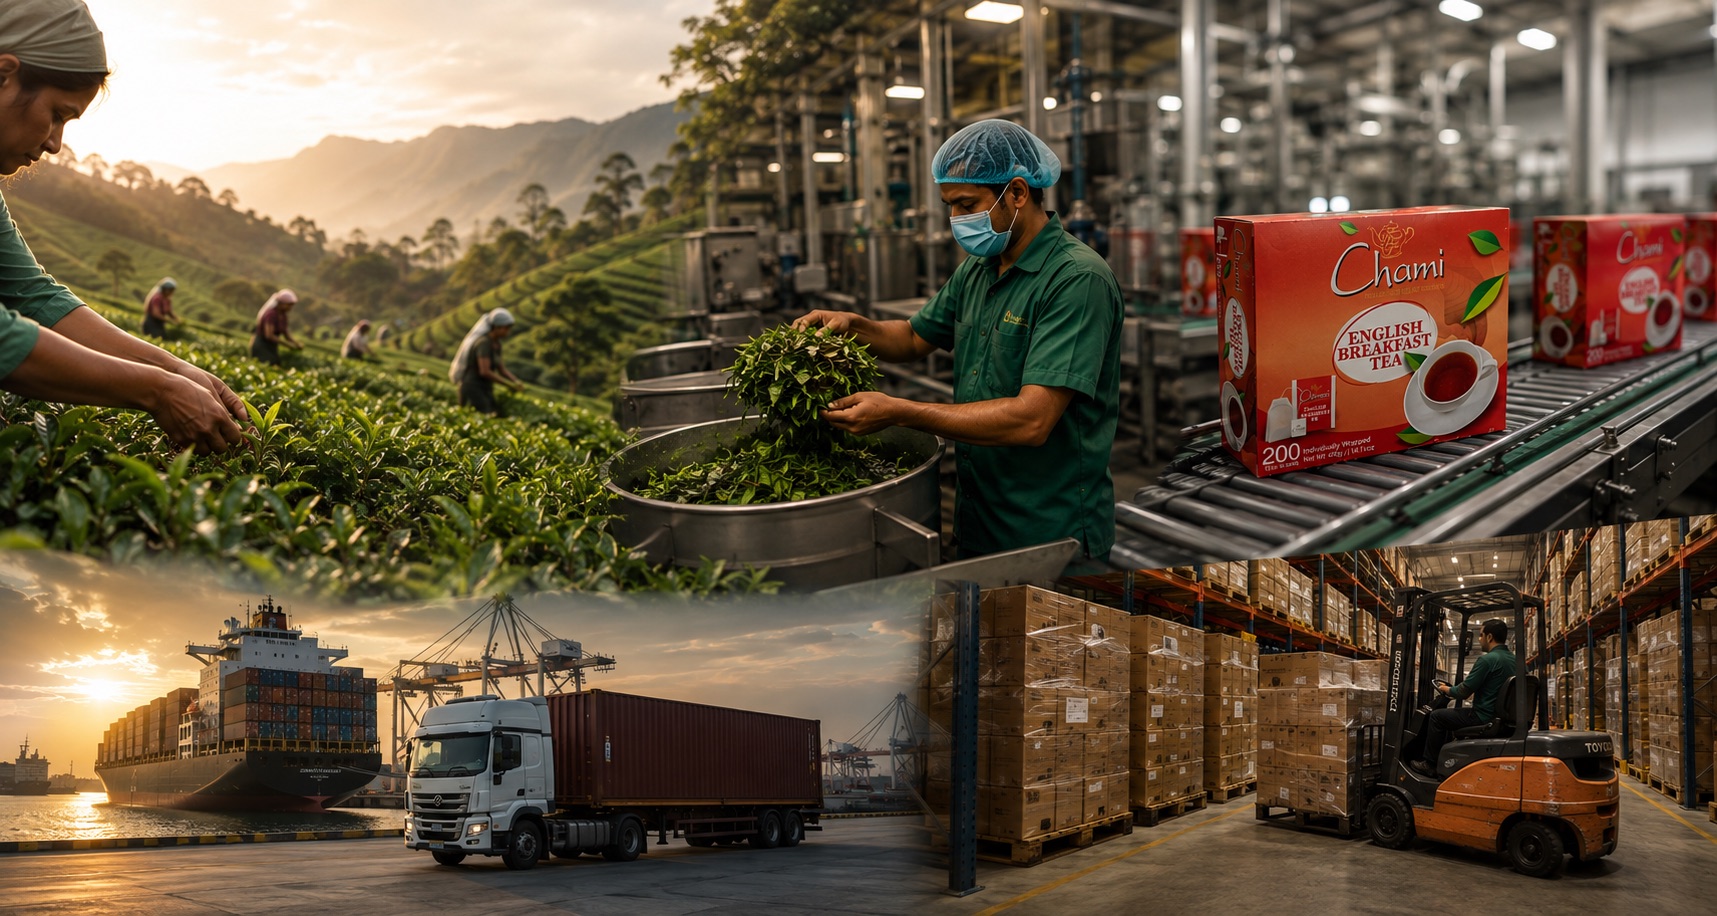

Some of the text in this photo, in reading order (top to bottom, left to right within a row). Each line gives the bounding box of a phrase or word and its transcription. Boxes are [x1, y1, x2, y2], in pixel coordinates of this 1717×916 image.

[1330, 242, 1444, 297] Chami
[1348, 320, 1423, 345] ENGLISH
[1338, 333, 1432, 361] BREAKFAST
[1370, 353, 1402, 370] TEA
[1262, 443, 1301, 465] 200
